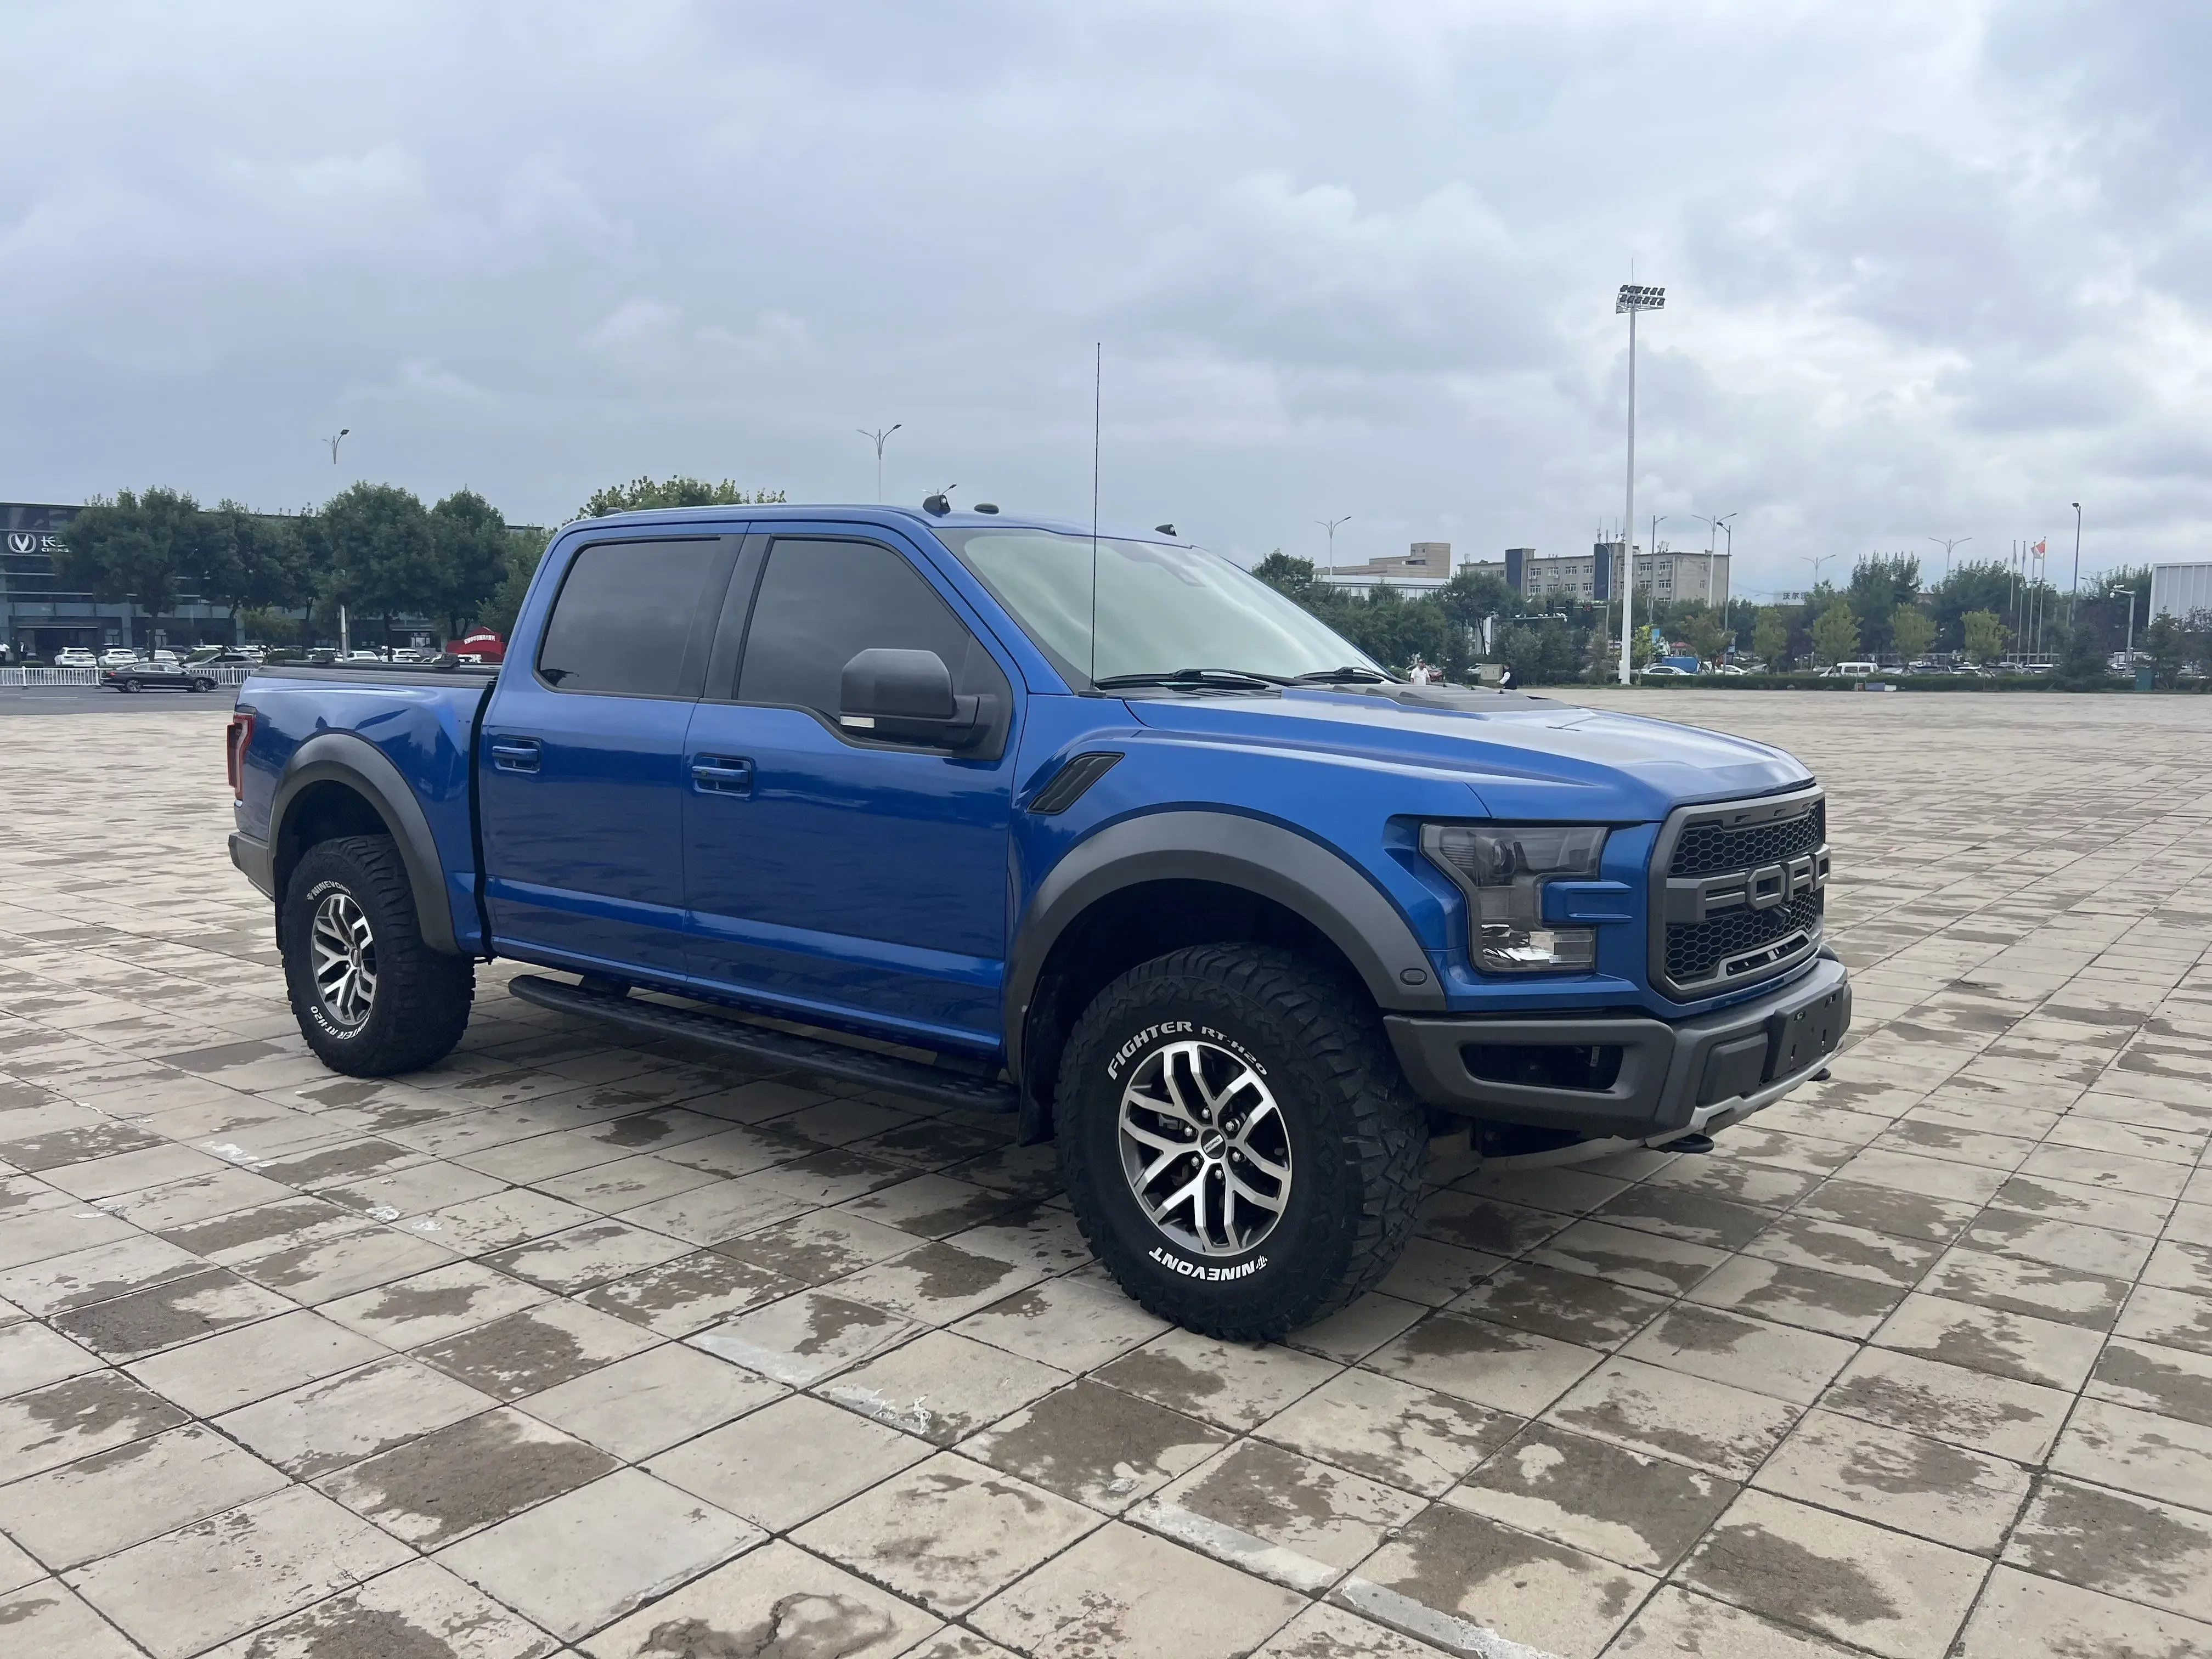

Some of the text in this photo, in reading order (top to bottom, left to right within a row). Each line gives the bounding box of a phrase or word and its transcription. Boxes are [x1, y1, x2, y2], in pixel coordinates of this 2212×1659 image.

[1697, 843, 1831, 921] FORD
[1108, 1020, 1193, 1080] FIGHTER
[1148, 1246, 1255, 1281] NINEVONT
